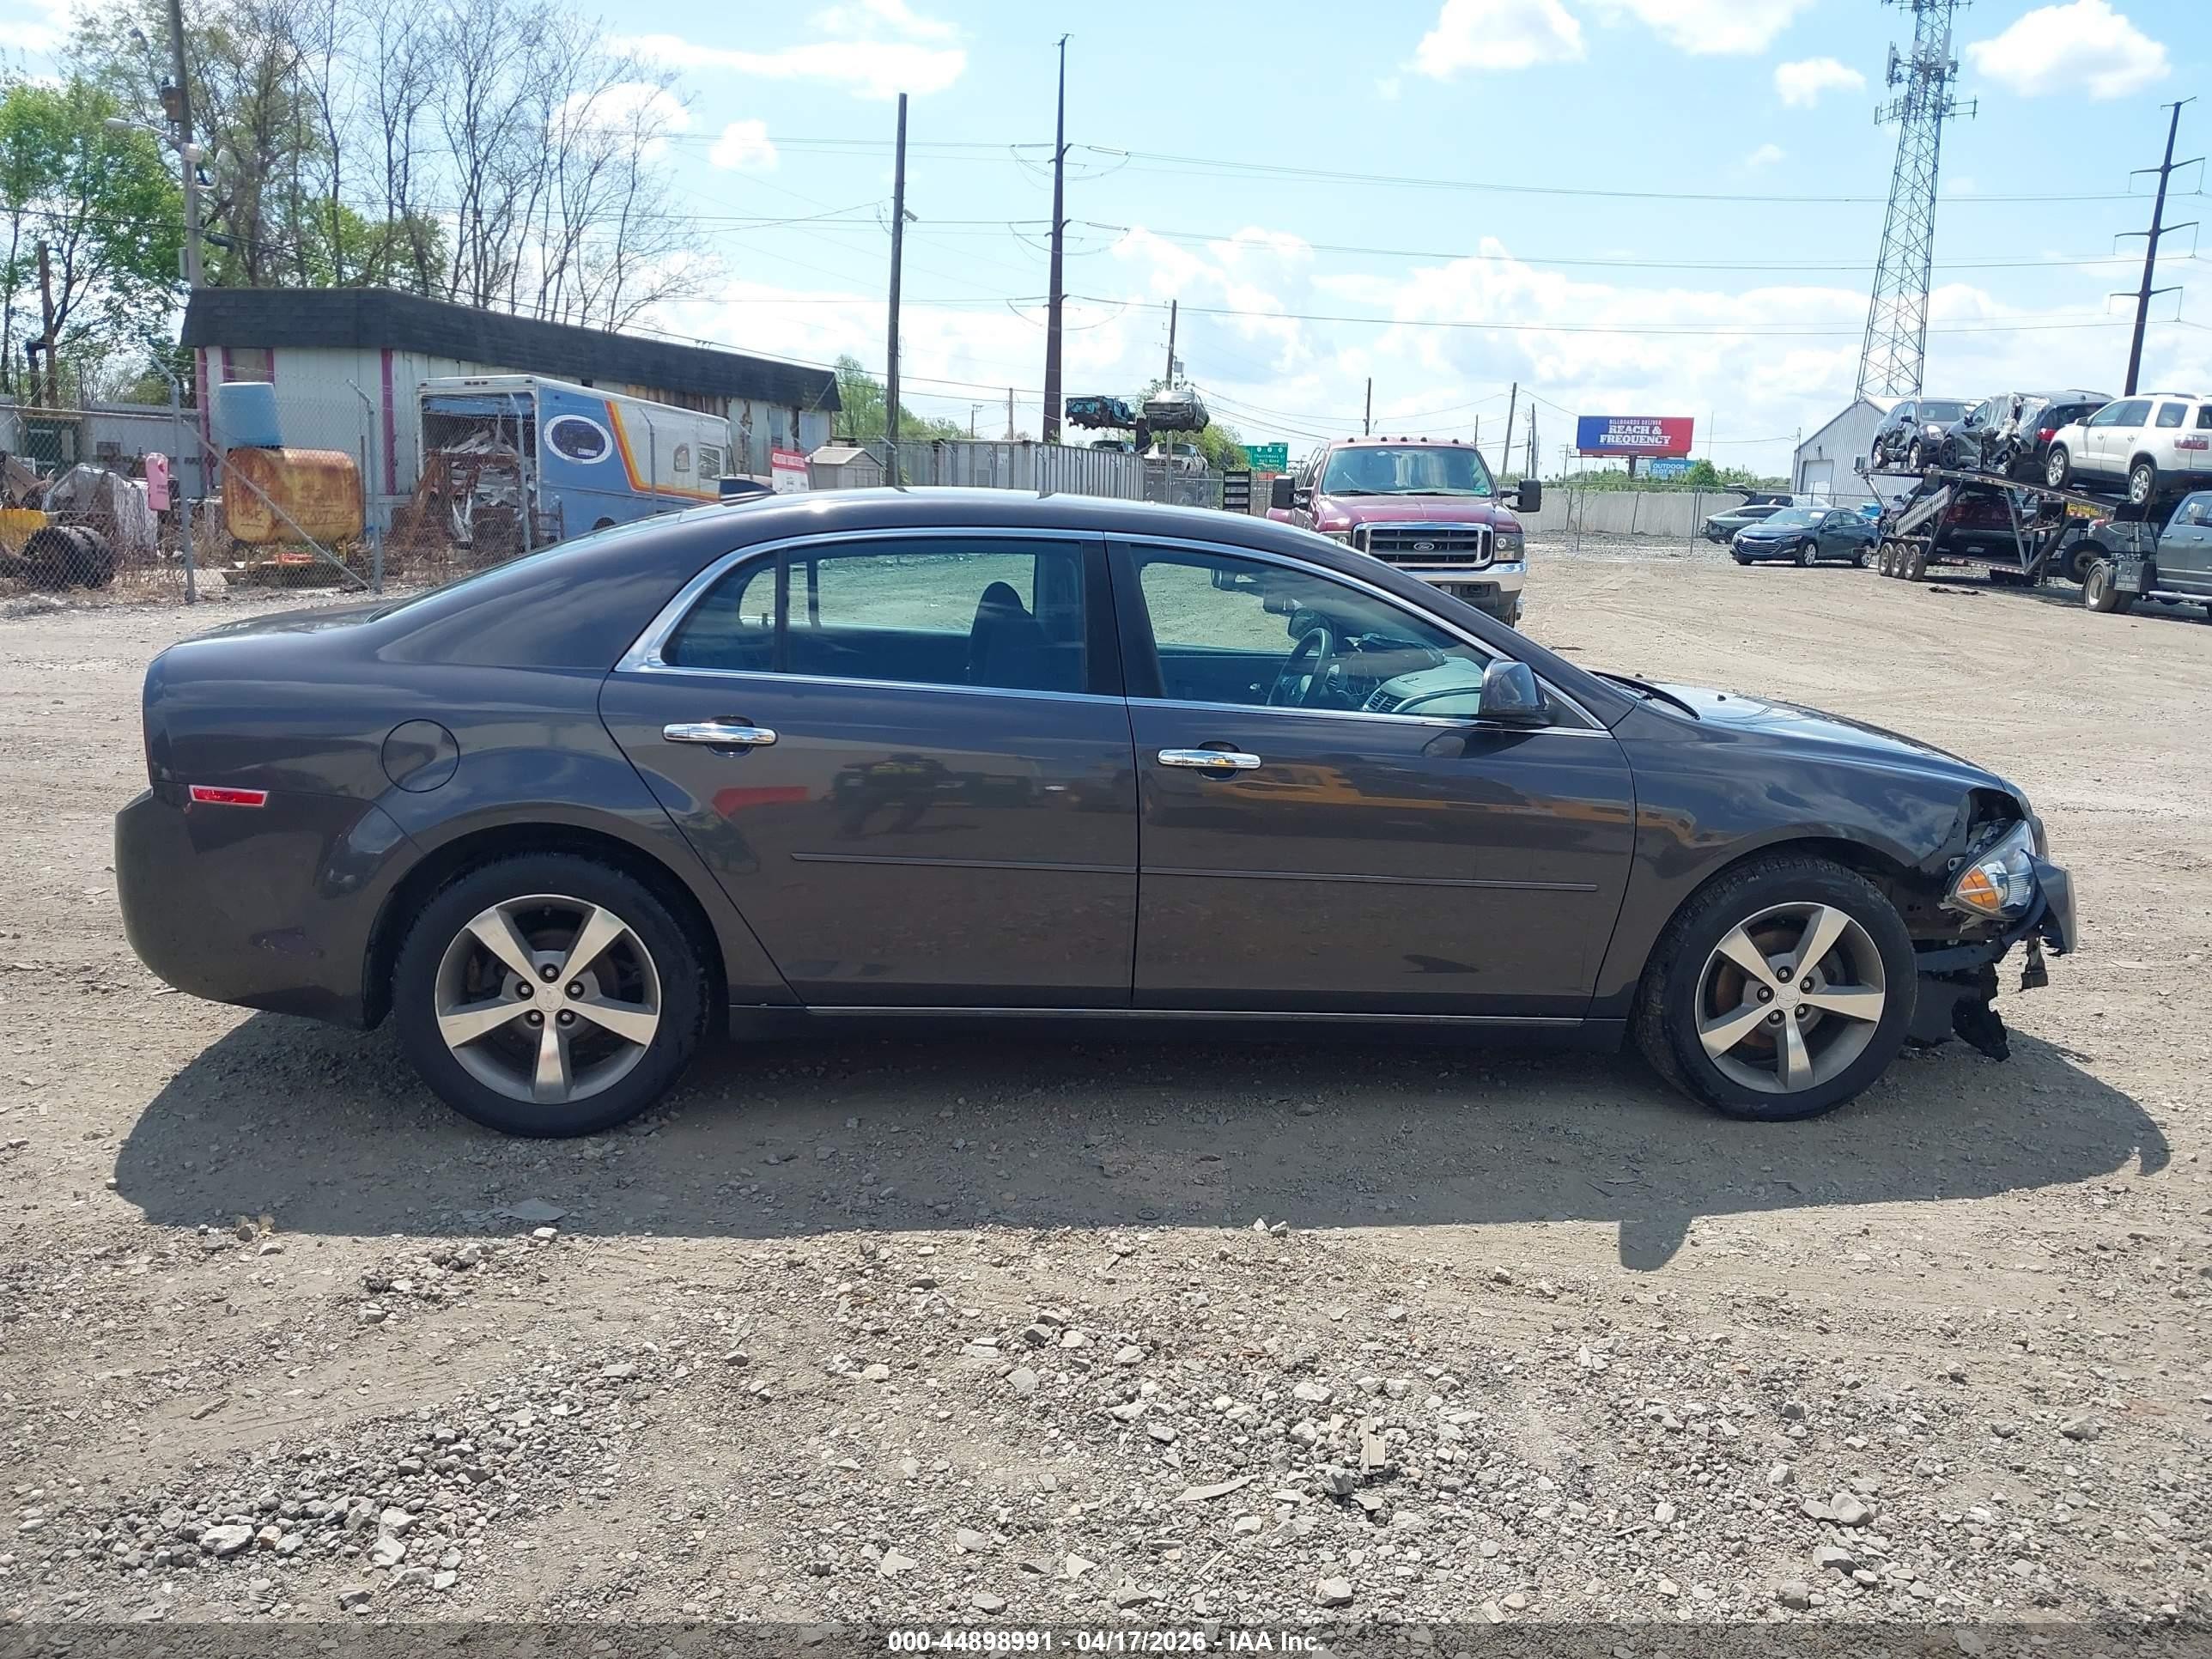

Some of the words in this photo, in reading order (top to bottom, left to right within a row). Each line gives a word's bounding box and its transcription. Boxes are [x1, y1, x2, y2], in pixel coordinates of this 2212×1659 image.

[1608, 425, 1650, 434] REACH
[1651, 426, 1662, 434] &
[1599, 435, 1672, 445] FREQUENCY
